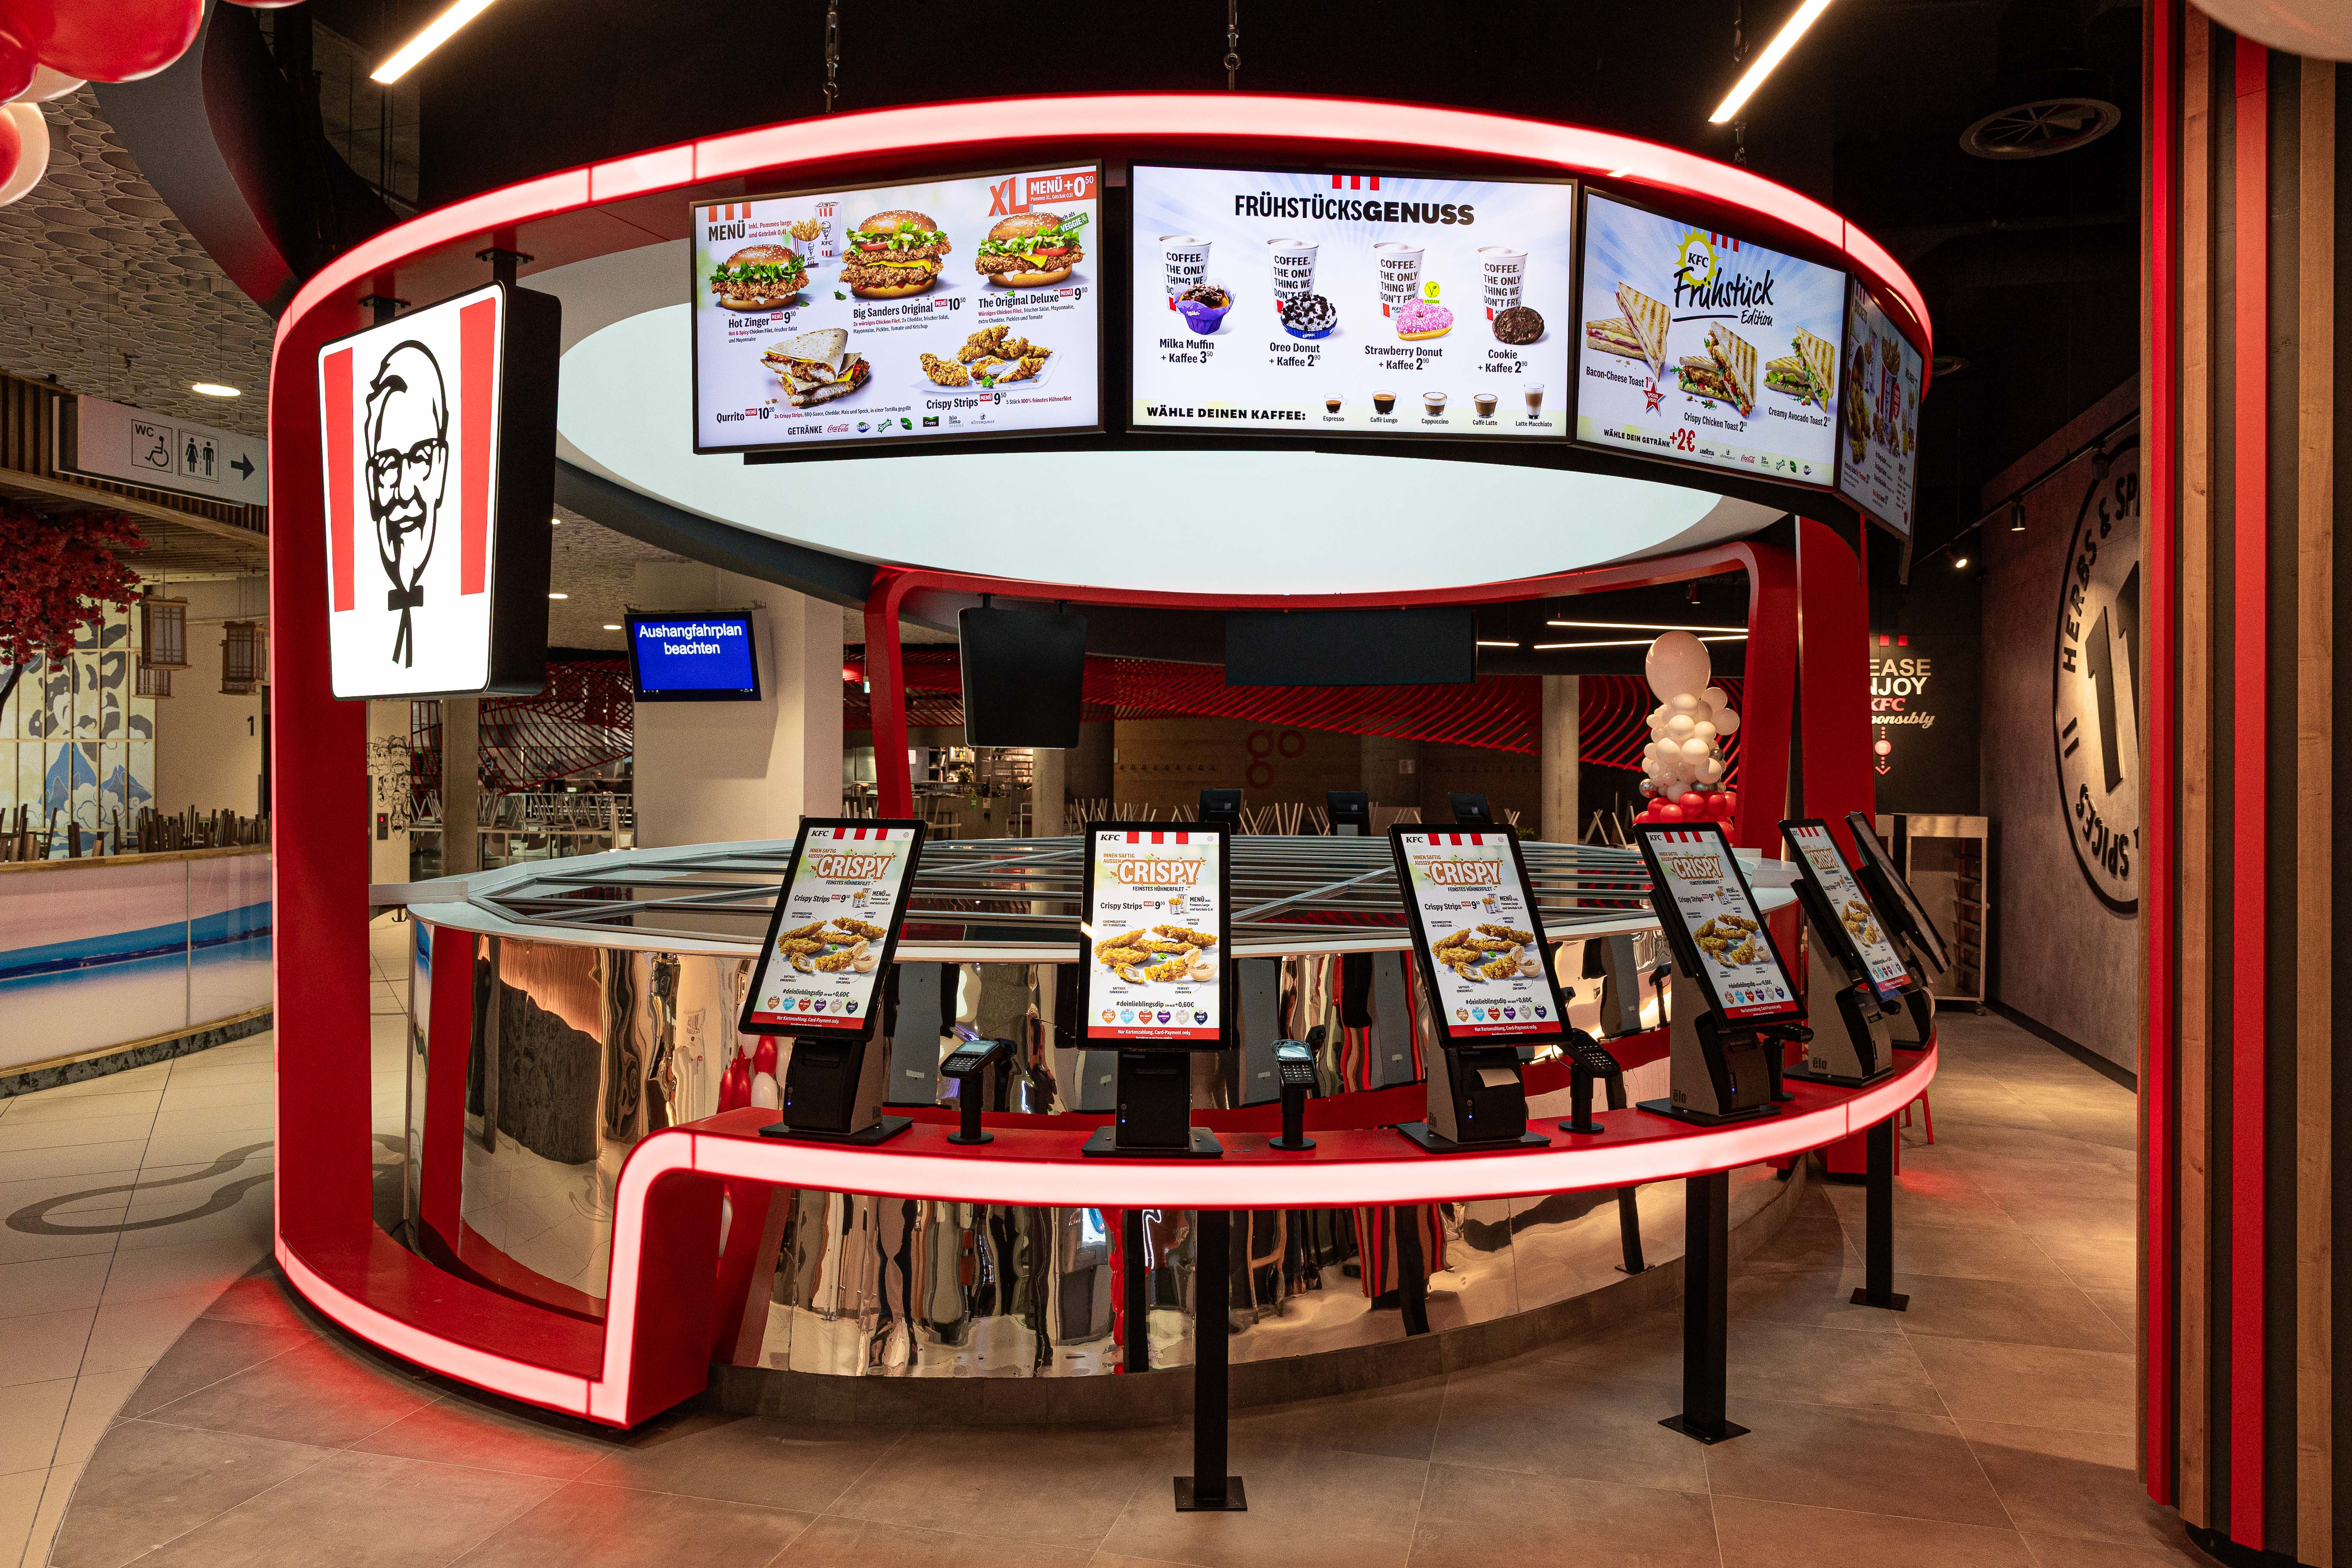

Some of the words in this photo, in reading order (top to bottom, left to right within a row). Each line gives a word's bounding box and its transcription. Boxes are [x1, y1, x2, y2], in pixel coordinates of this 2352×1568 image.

[989, 177, 1029, 216] XL
[1030, 176, 1062, 195] MENÜ
[1235, 191, 1475, 225] FRÜHSTÜCKSGENUSS
[709, 220, 745, 242] MENÜ
[1060, 217, 1082, 233] VEGGIE
[1687, 252, 1709, 268] KFC
[1485, 263, 1519, 273] COFFEE.
[1484, 274, 1498, 285] THE
[1501, 275, 1521, 285] ONLY
[1484, 285, 1507, 296] THING
[1510, 286, 1519, 296] WE
[1673, 266, 1774, 309] Frühstück
[978, 298, 993, 308] The
[996, 294, 1028, 308] Original
[1031, 294, 1059, 304] Deluxe
[1484, 295, 1504, 307] DON'T
[854, 309, 866, 319] Big
[867, 306, 900, 317] Sanders
[902, 303, 934, 315] Original
[1741, 308, 1773, 327] Edition
[729, 319, 742, 328] Hot
[744, 317, 769, 328] Zinger
[1160, 338, 1184, 349] Milka
[1186, 339, 1214, 349] Muffin
[1270, 342, 1290, 352] Oreo
[1293, 343, 1320, 353] Donut
[1169, 353, 1197, 363] Kaffee
[1365, 345, 1414, 358] Strawberry
[1416, 347, 1442, 356] Donut
[1488, 349, 1517, 359] Cookie
[1277, 356, 1305, 366] Kaffee
[1387, 360, 1414, 370] Kaffee
[1485, 363, 1513, 373] Kaffee
[1586, 366, 1627, 383] Bacon-Cheese
[1629, 376, 1644, 387] Toast
[926, 400, 952, 410] Crispy
[954, 398, 978, 409] Strips
[717, 411, 744, 423] Qurrito
[1147, 404, 1194, 417] WÄHLE
[1198, 408, 1247, 419] DEINEN
[1252, 410, 1306, 420] KAFFEE:
[1768, 407, 1788, 421] Creamy
[1788, 411, 1809, 423] Avocado
[1810, 416, 1823, 426] Toast
[1684, 412, 1701, 425] Crispy
[1702, 416, 1723, 428] Chicken
[1724, 420, 1739, 431] Toast
[135, 424, 154, 438] WC
[788, 425, 823, 435] GETRÄNKE
[1604, 428, 1625, 440] WÄHLE
[1626, 433, 1641, 442] DEIN
[1642, 436, 1670, 448] GETRÄNK
[639, 623, 742, 640] Aushangfahrplan
[664, 642, 720, 655] beachten
[247, 716, 254, 736] 1
[818, 855, 891, 878] CRISPY
[1118, 860, 1200, 884] CRISPY
[1430, 861, 1500, 884] CRISPY
[1674, 857, 1723, 879] CRISPY
[794, 895, 812, 903] Crispy
[1100, 902, 1121, 910] Crispy
[1123, 903, 1142, 911] Strips
[1424, 903, 1443, 911] Crispy
[1444, 901, 1462, 911] Strips
[783, 989, 824, 997] #deinlieblingsdip
